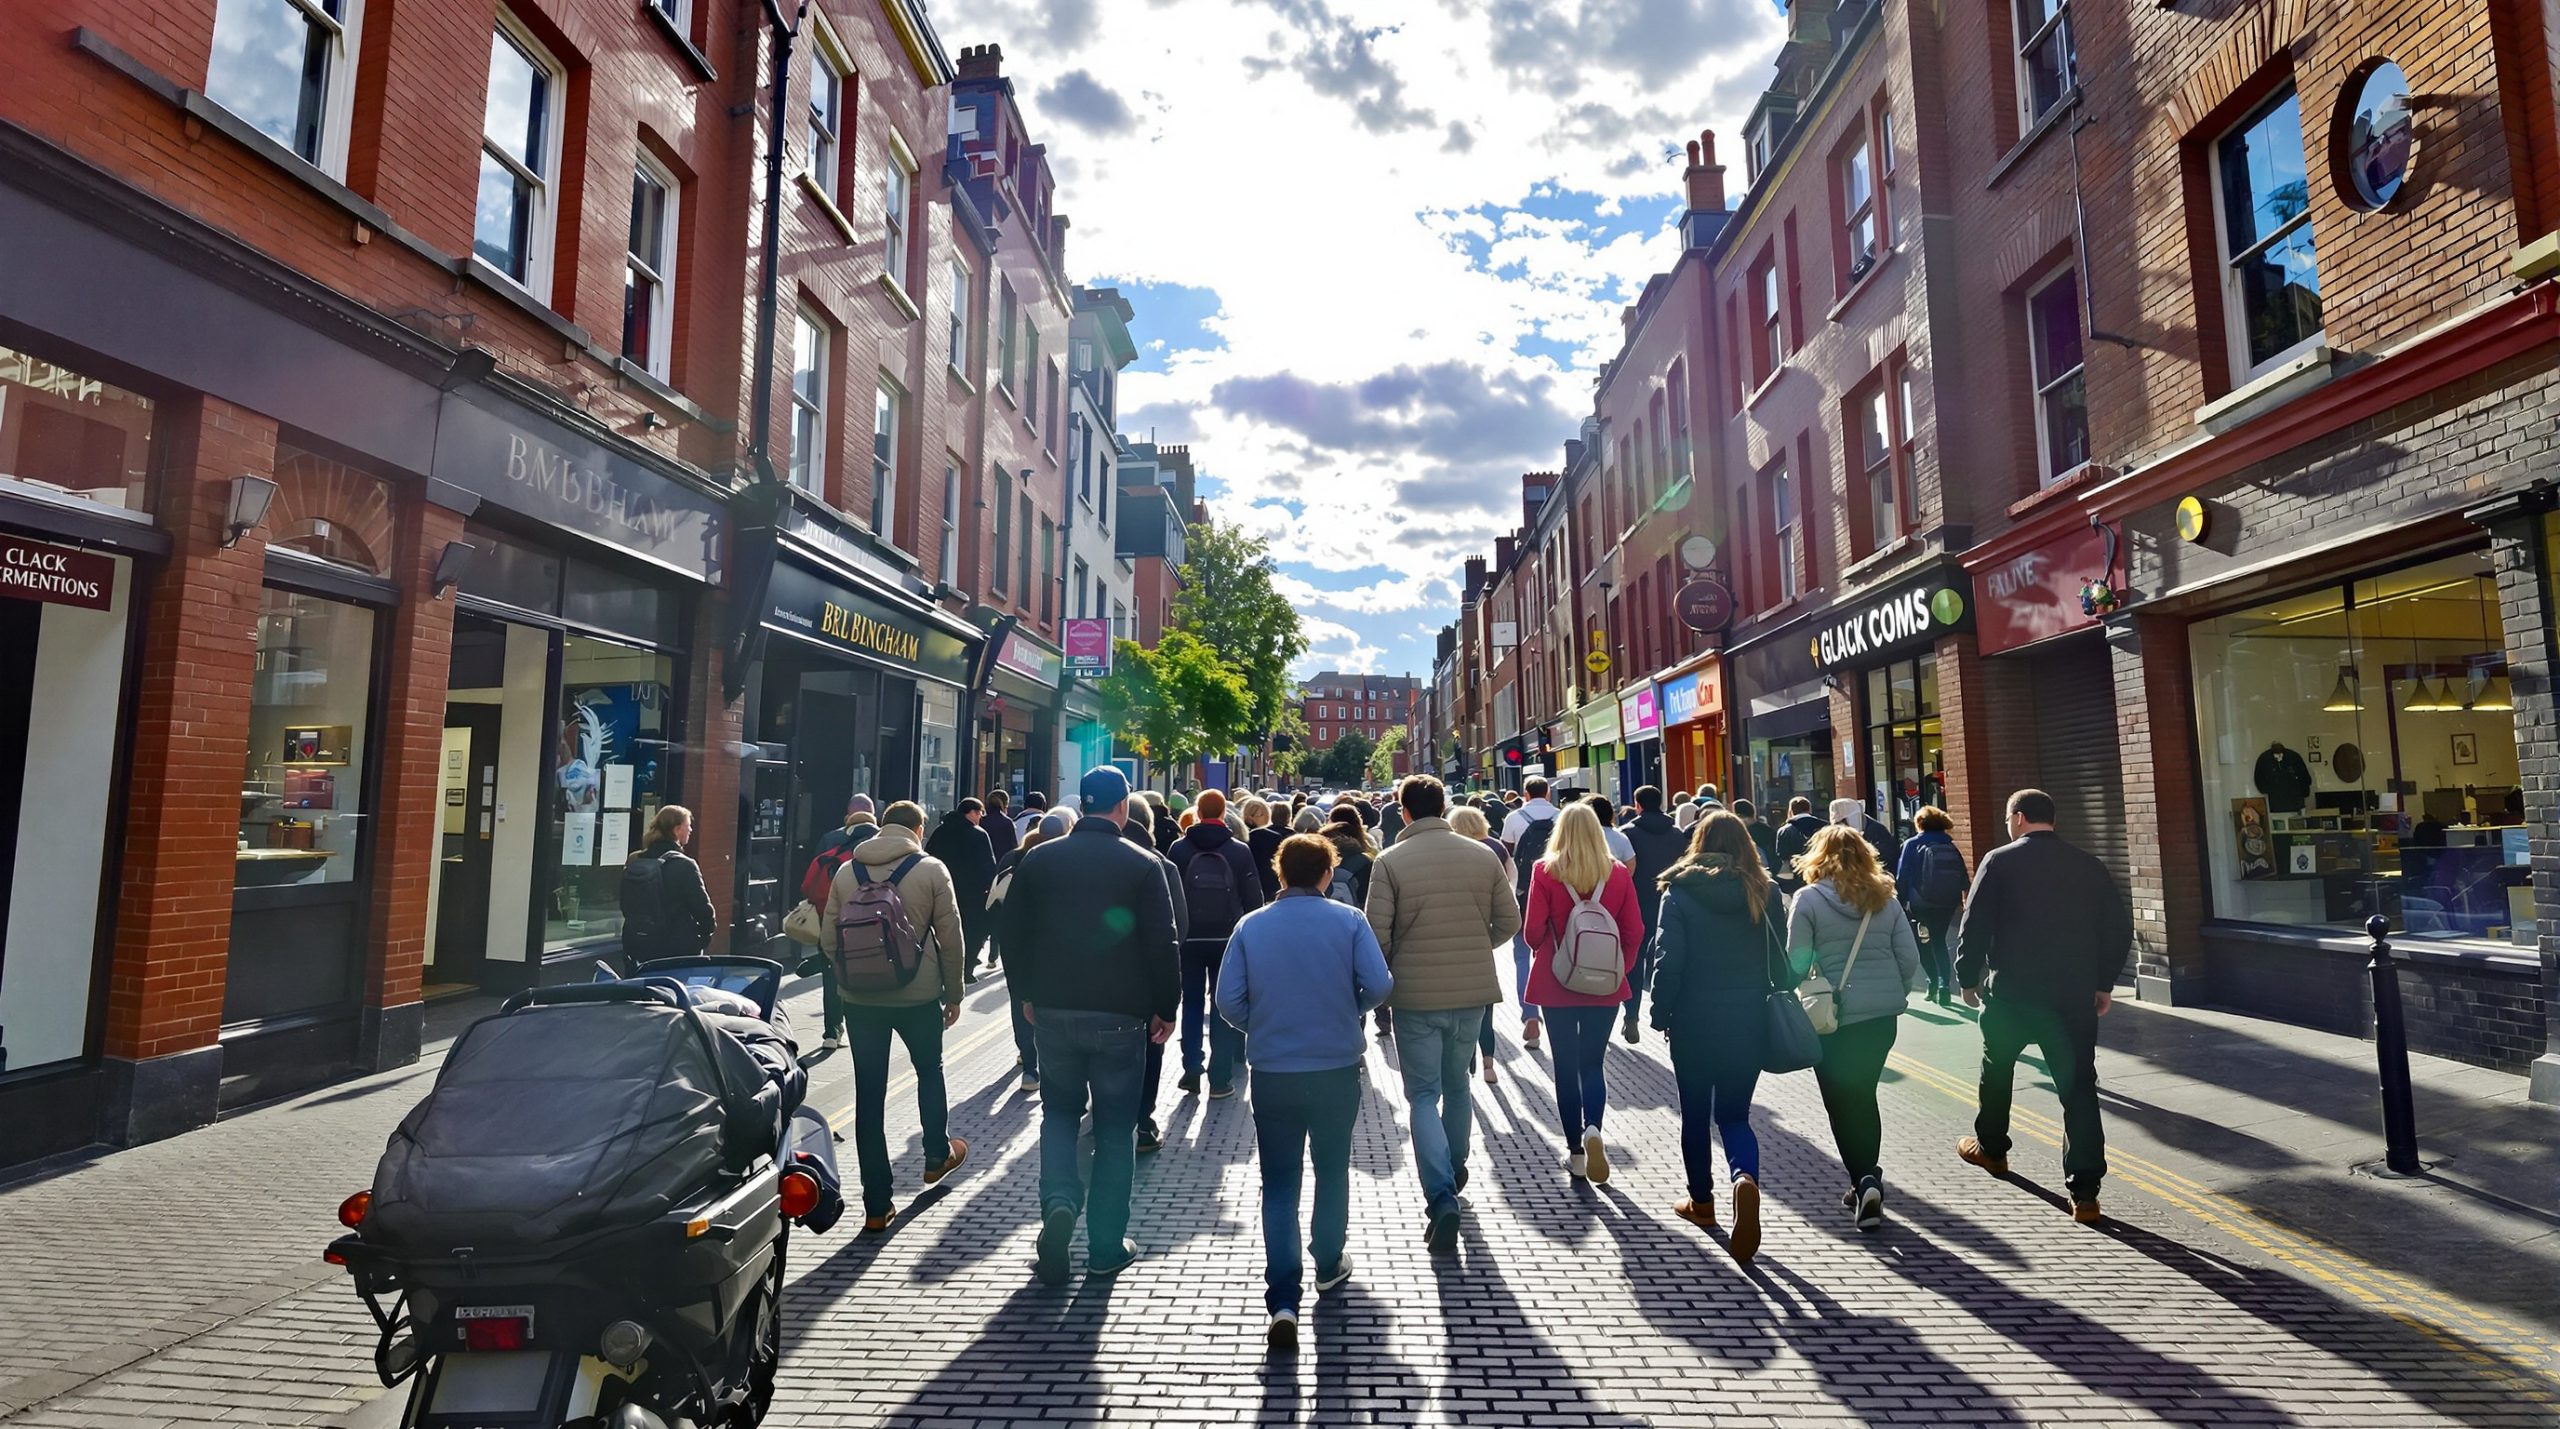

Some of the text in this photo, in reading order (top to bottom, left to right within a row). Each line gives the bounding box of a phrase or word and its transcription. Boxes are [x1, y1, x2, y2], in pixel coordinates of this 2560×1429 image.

[5, 548, 68, 573] CLACK
[0, 567, 99, 599] RMENTIONS
[1820, 587, 1930, 666] GLACK COMS
